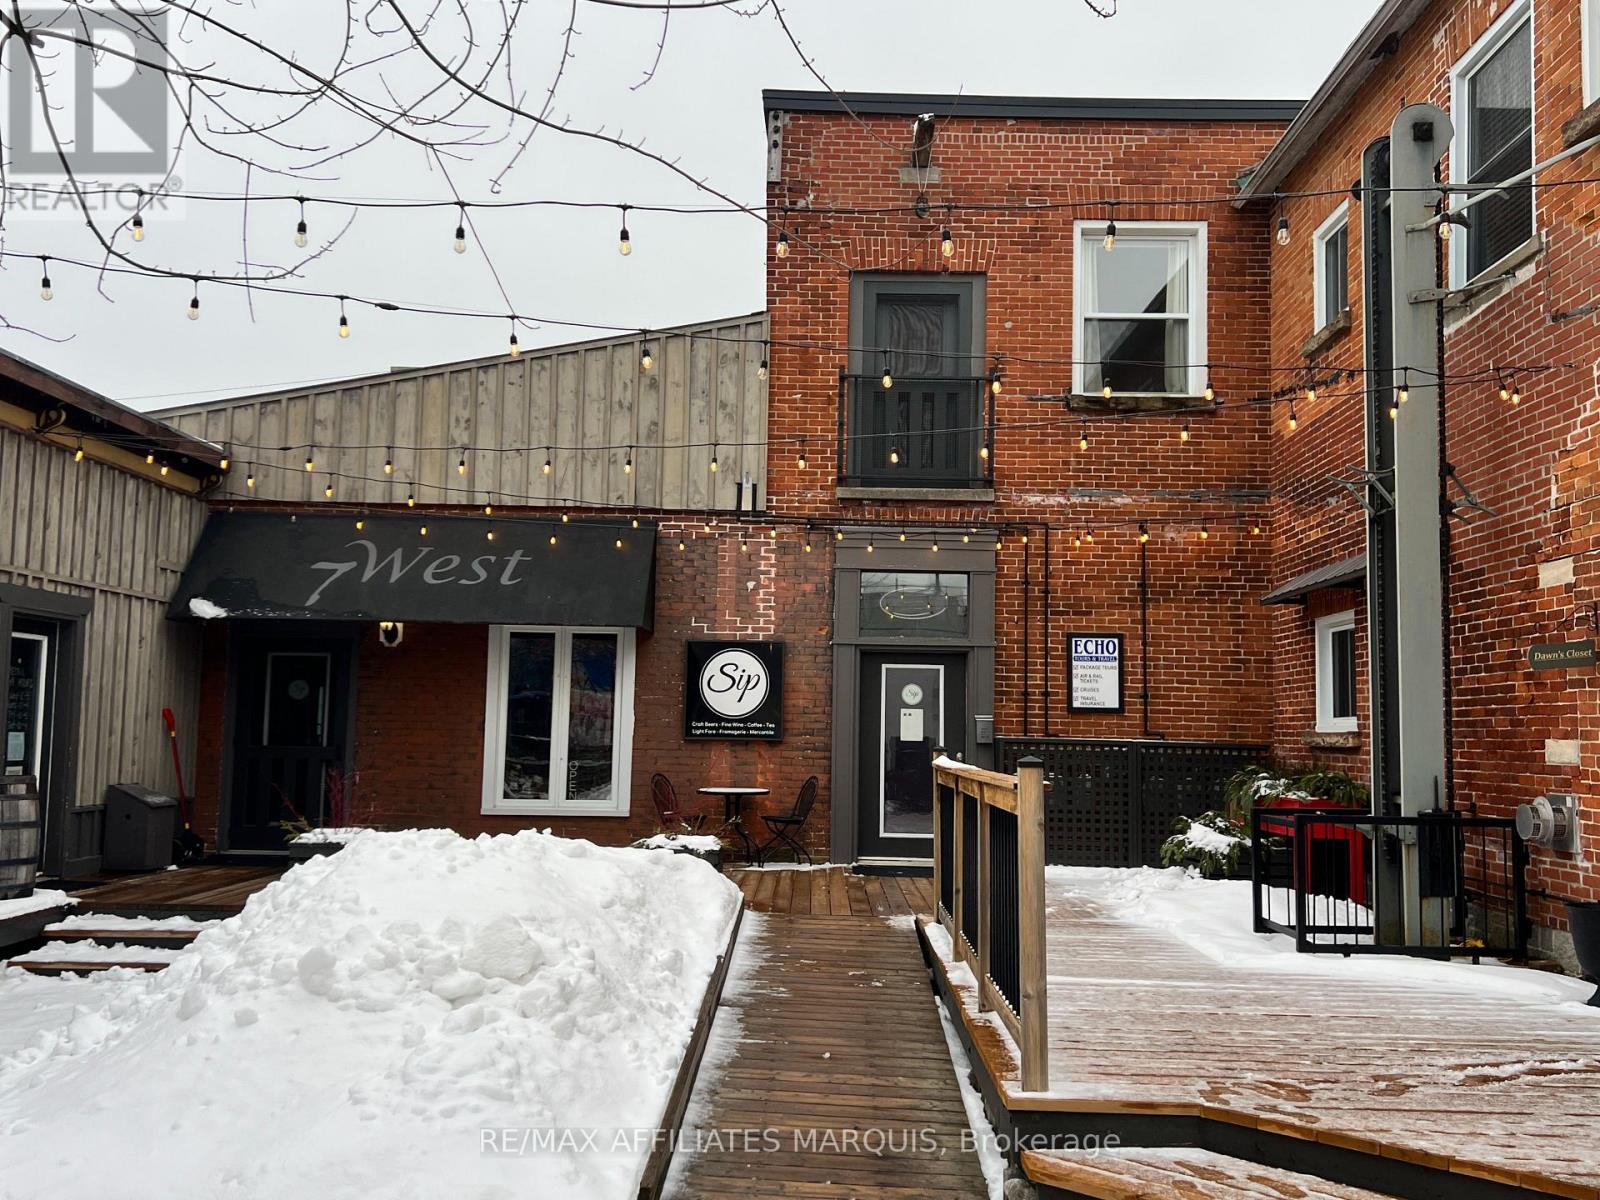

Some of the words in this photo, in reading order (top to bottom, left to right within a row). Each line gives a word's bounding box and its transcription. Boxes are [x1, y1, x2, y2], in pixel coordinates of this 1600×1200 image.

[1073, 639, 1117, 655] ECHO
[1534, 650, 1565, 661] Dawn's
[1566, 649, 1593, 658] Closet
[707, 662, 761, 703] Sip
[568, 760, 579, 800] OPEN
